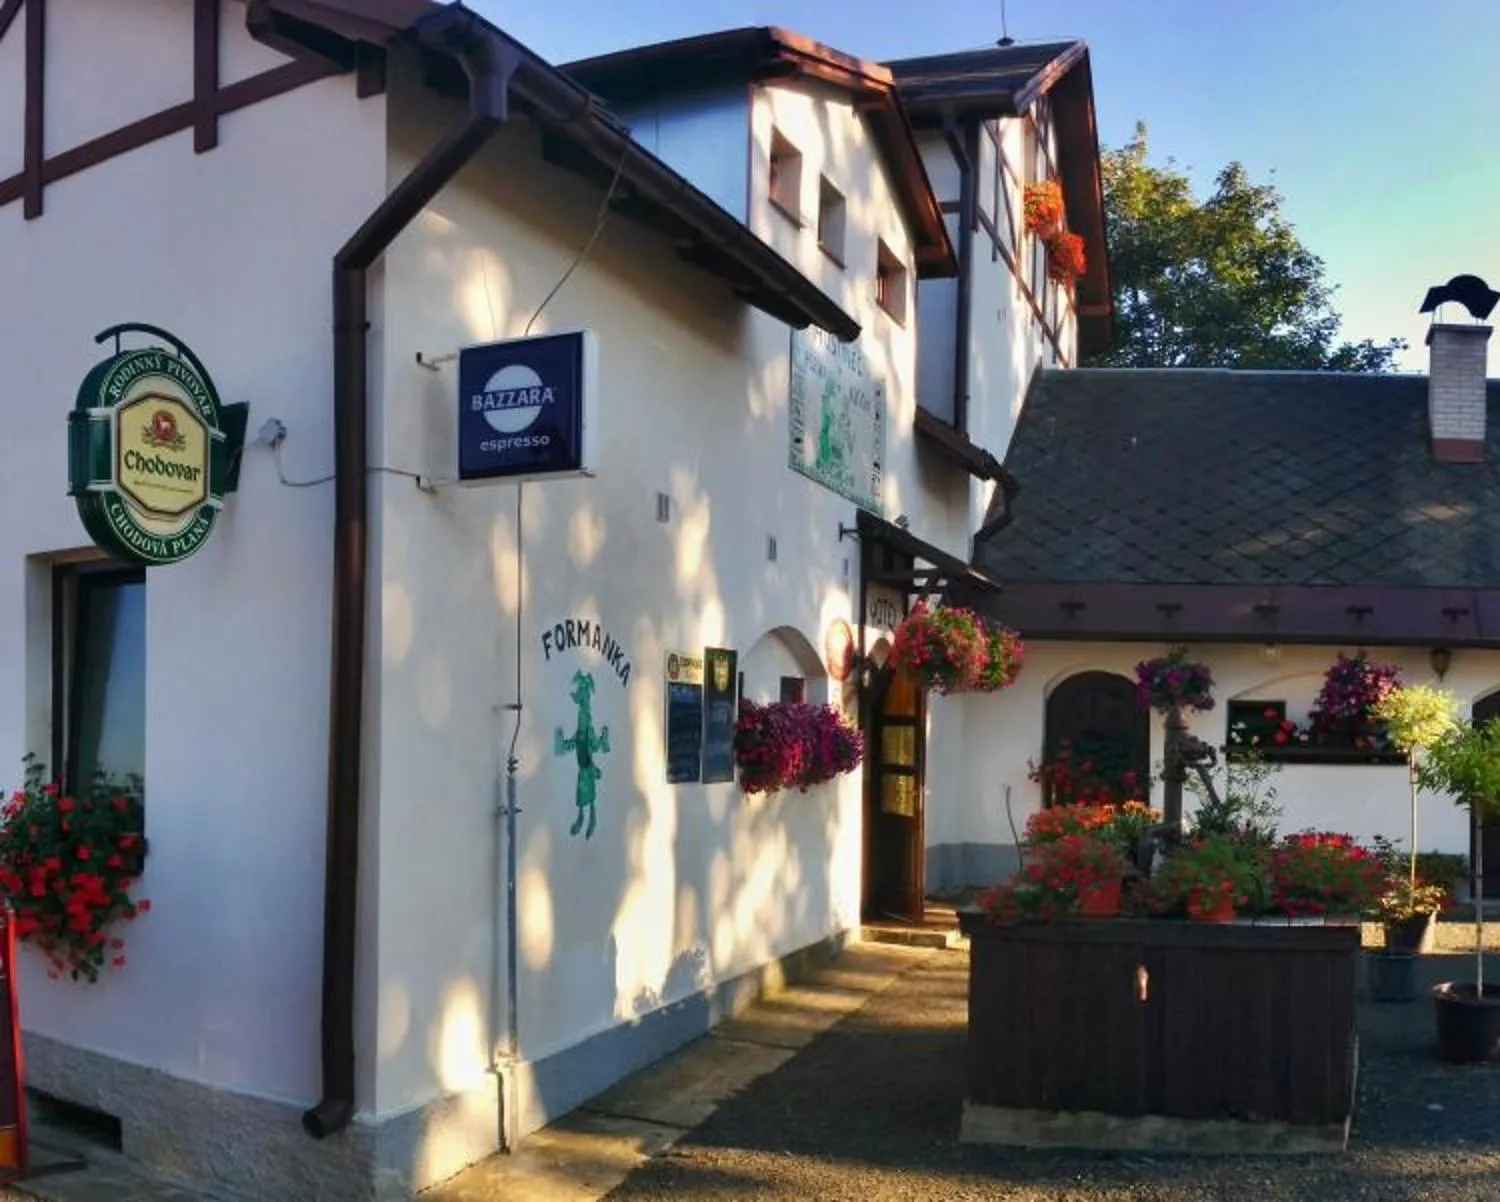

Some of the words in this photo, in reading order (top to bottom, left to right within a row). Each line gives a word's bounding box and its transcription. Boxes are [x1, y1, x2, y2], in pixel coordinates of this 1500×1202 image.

[471, 388, 555, 411] BAZZARA
[480, 435, 550, 452] espresso
[542, 619, 631, 688] FORMANKA
